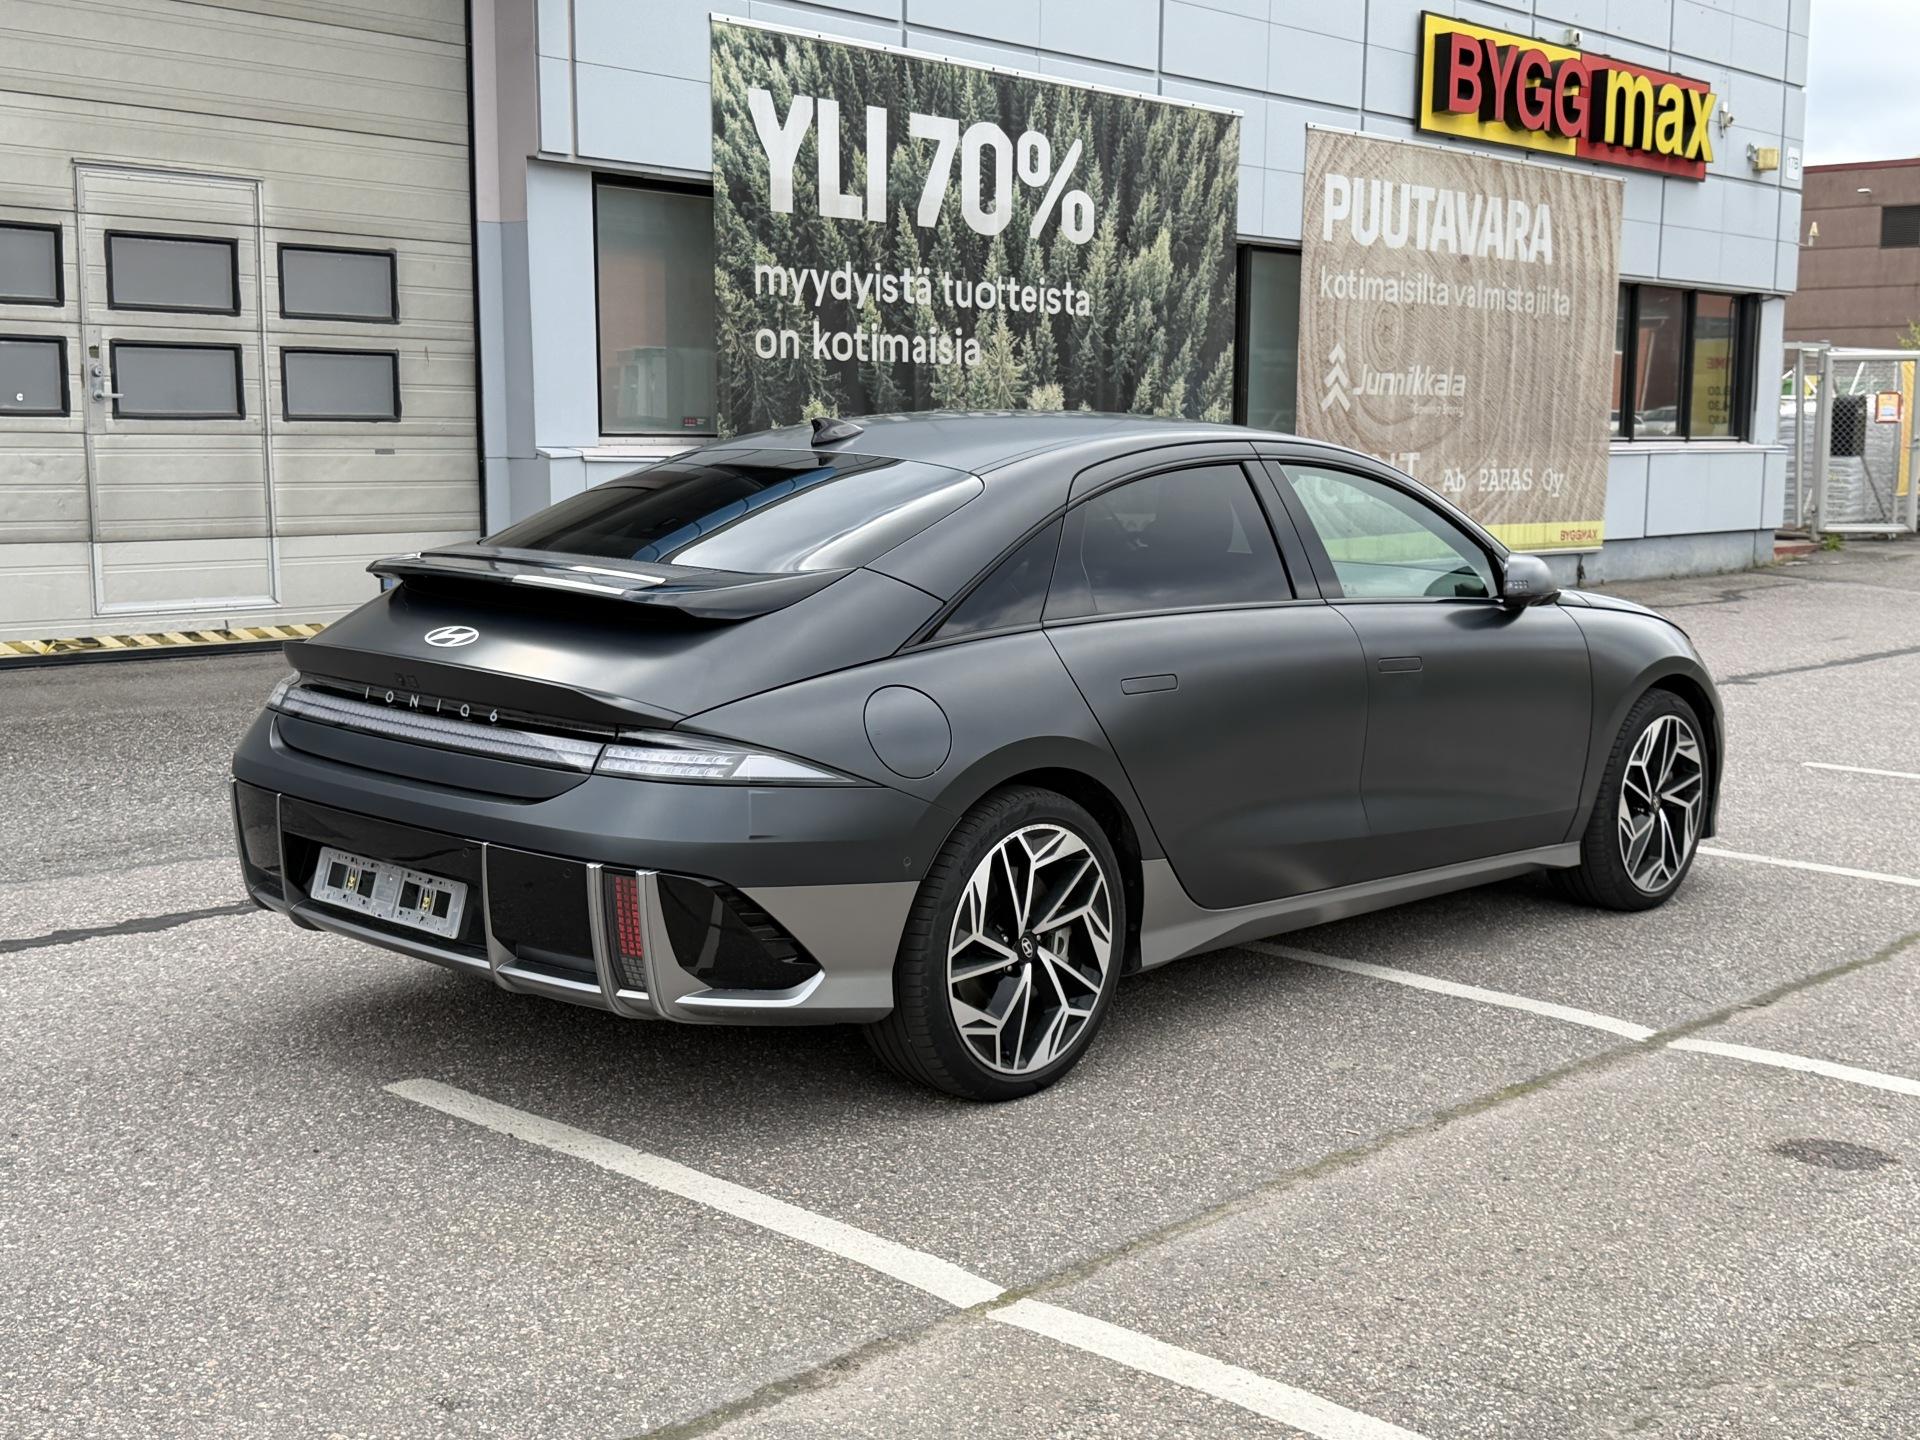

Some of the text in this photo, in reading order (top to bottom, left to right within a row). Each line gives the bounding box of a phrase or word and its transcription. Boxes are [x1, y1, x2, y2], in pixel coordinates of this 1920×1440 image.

[748, 87, 1094, 245] YLI 70%
[1322, 173, 1553, 265] PUUTAVARA
[755, 261, 1091, 317] myydyistä tuotteista
[1320, 266, 1571, 318] kotimaisilta valmistajilta
[755, 322, 981, 366] on kotimaisia
[1352, 364, 1466, 397] Junnikkala
[1442, 467, 1466, 493] Ab
[1542, 467, 1564, 497] Oy
[1560, 529, 1598, 541] BYGGMAX
[365, 686, 498, 722] IONIQ 6
